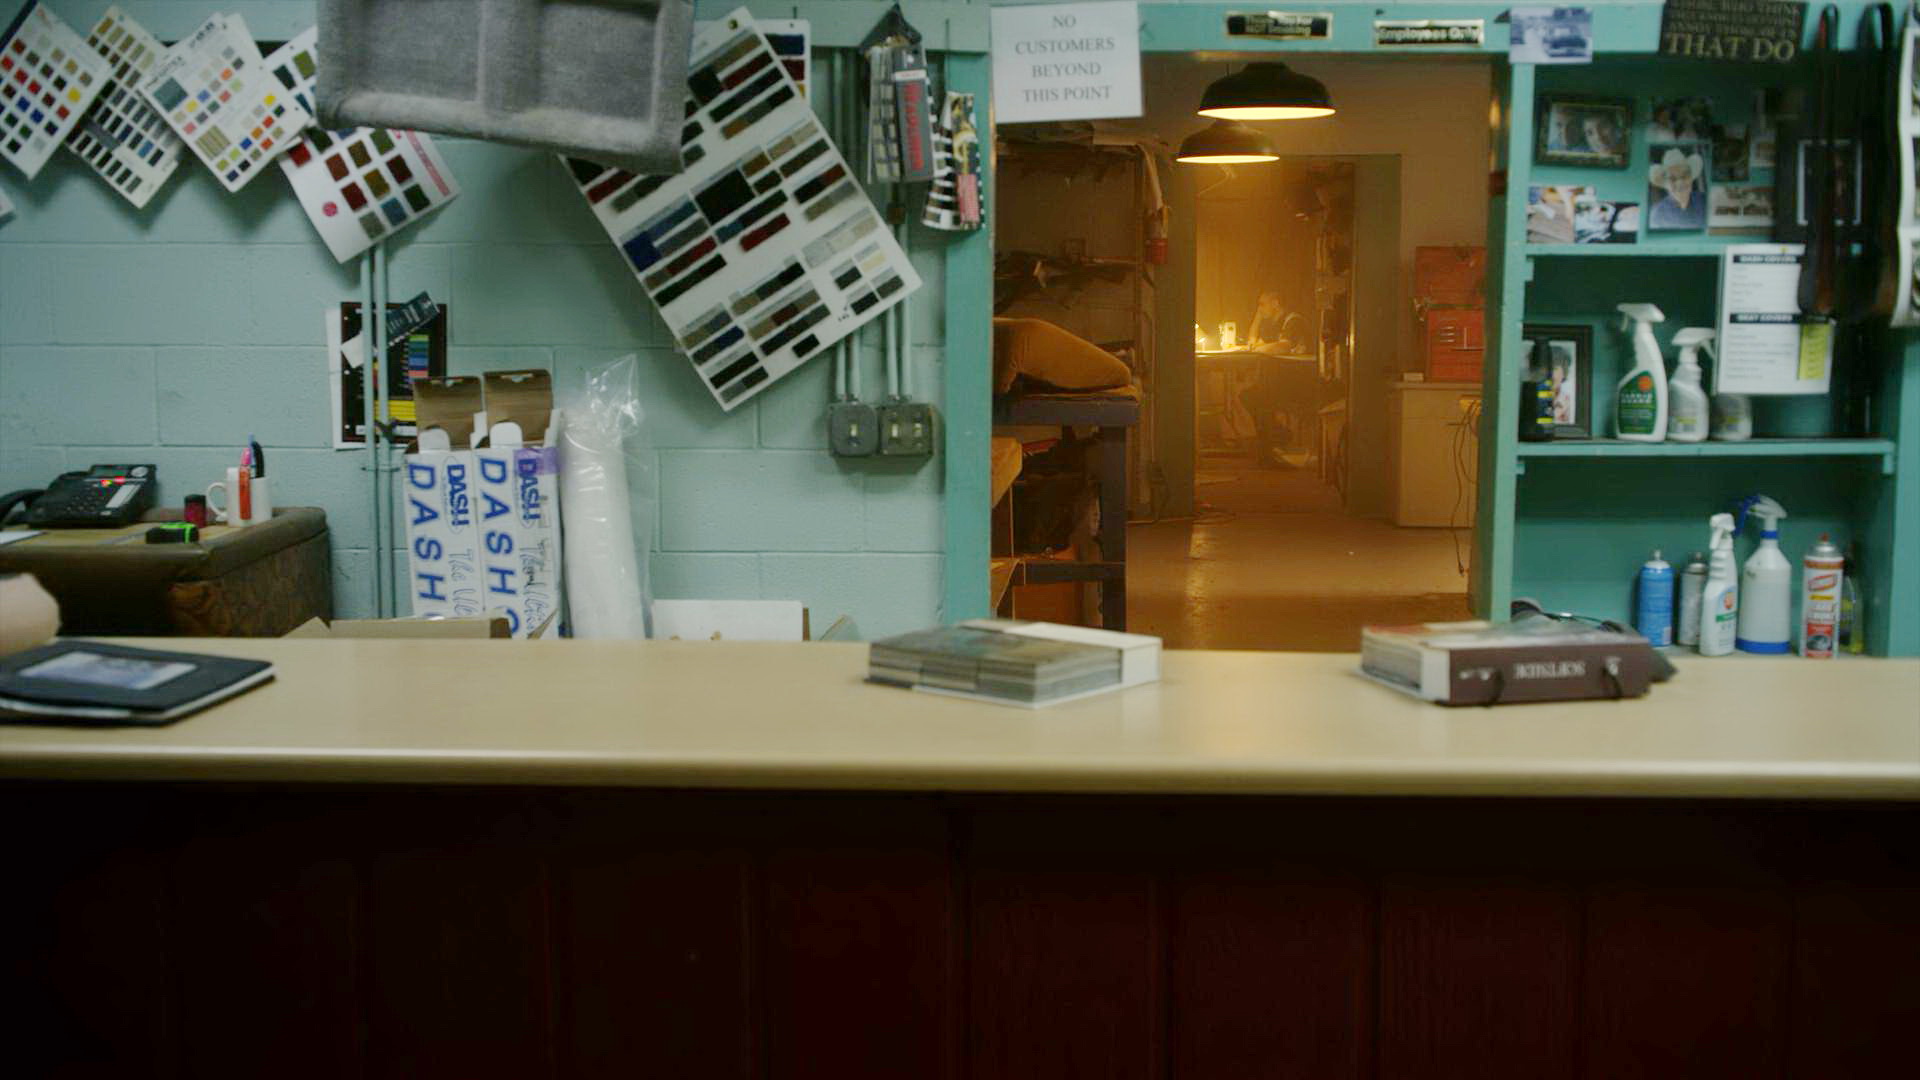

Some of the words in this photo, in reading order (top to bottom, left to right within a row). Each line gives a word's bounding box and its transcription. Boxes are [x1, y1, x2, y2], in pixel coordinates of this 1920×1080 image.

[1052, 14, 1077, 28] NO
[1378, 27, 1447, 42] Employees
[1449, 26, 1481, 42] Only
[1015, 37, 1115, 55] CUSTOMERS
[1665, 31, 1746, 58] THAT
[1752, 37, 1796, 61] DO
[1032, 62, 1101, 78] BEYOND
[1024, 88, 1059, 102] THIS
[1064, 85, 1112, 100] POINT
[408, 463, 447, 617] DASH
